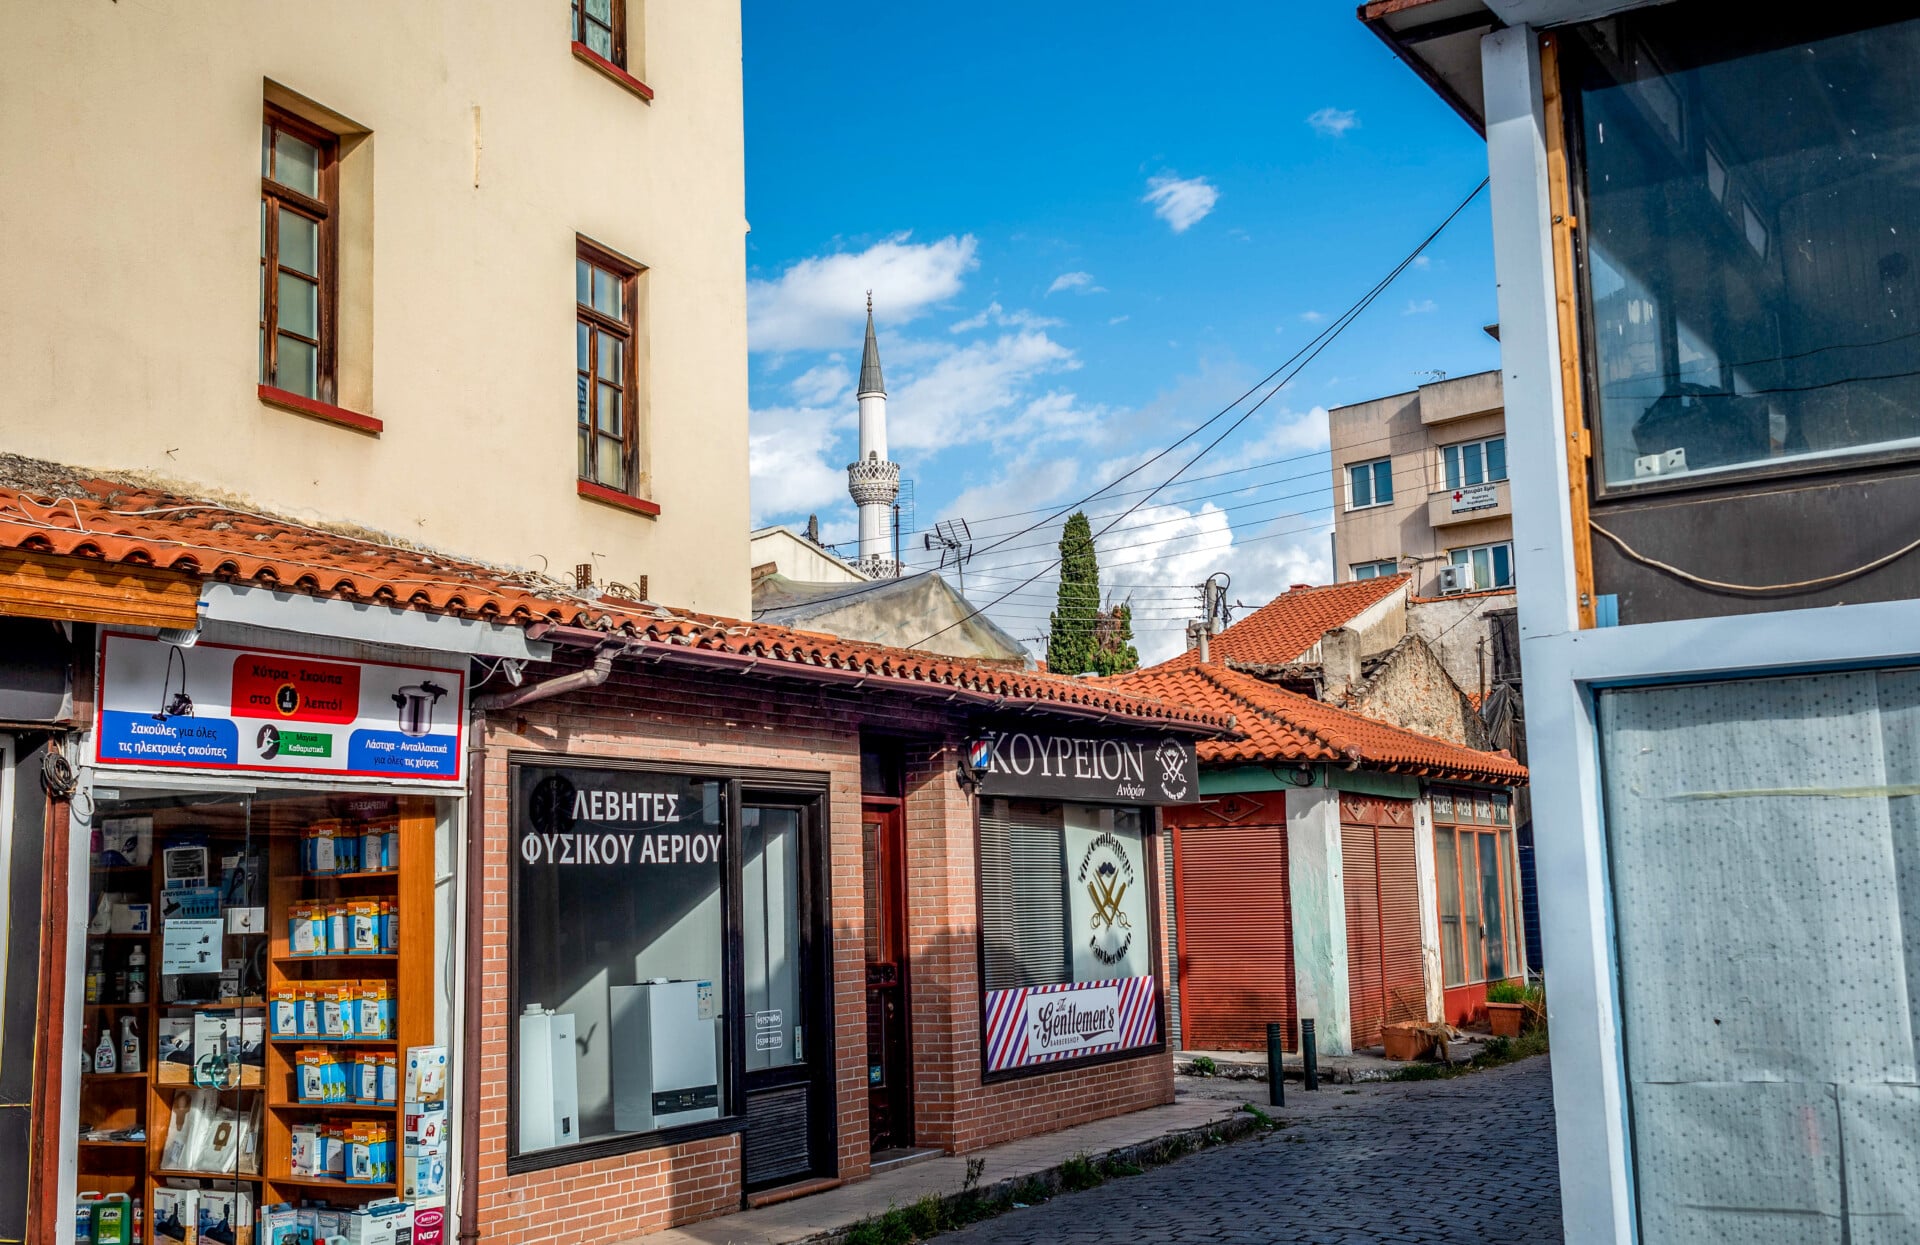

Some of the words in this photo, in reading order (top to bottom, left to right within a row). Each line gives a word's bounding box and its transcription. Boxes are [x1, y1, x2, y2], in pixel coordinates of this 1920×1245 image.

[252, 665, 289, 680] Χύτρα
[300, 670, 343, 685] Σκούπα
[249, 694, 271, 705] στο
[285, 690, 291, 701] 1
[304, 696, 343, 711] λεπτό!
[131, 722, 177, 738] Σακούλες
[178, 728, 194, 739] για
[196, 726, 217, 739] όλες
[118, 742, 132, 753] τις
[134, 740, 187, 756] ηλεκτρικές
[188, 744, 228, 759] σκούπες
[288, 744, 324, 754] Καθαριστικά
[365, 739, 395, 752] Λάστιχα
[400, 741, 448, 754] Ανταλλακτικά
[374, 756, 386, 765] για
[387, 755, 403, 766] όλες
[404, 758, 414, 767] τις
[415, 756, 439, 769] χύτρες
[987, 731, 1145, 781] ΚΟΥΡΕΙΟΝ
[572, 790, 680, 822] ΛΕΒΗΤΕΣ
[521, 832, 635, 865] ΦΥΣΙΚΟΥ
[640, 834, 722, 864] ΑΕΡΙΟΥ
[278, 992, 293, 1000] bags
[324, 992, 339, 1000] bags
[362, 990, 378, 998] bags
[1038, 1002, 1115, 1048] Gentlemen's
[1050, 1037, 1079, 1047] BARBERSHOP
[304, 1055, 319, 1064] bags
[353, 1134, 368, 1142] bags
[103, 1210, 118, 1218] Lite
[418, 1229, 440, 1241] NG7
